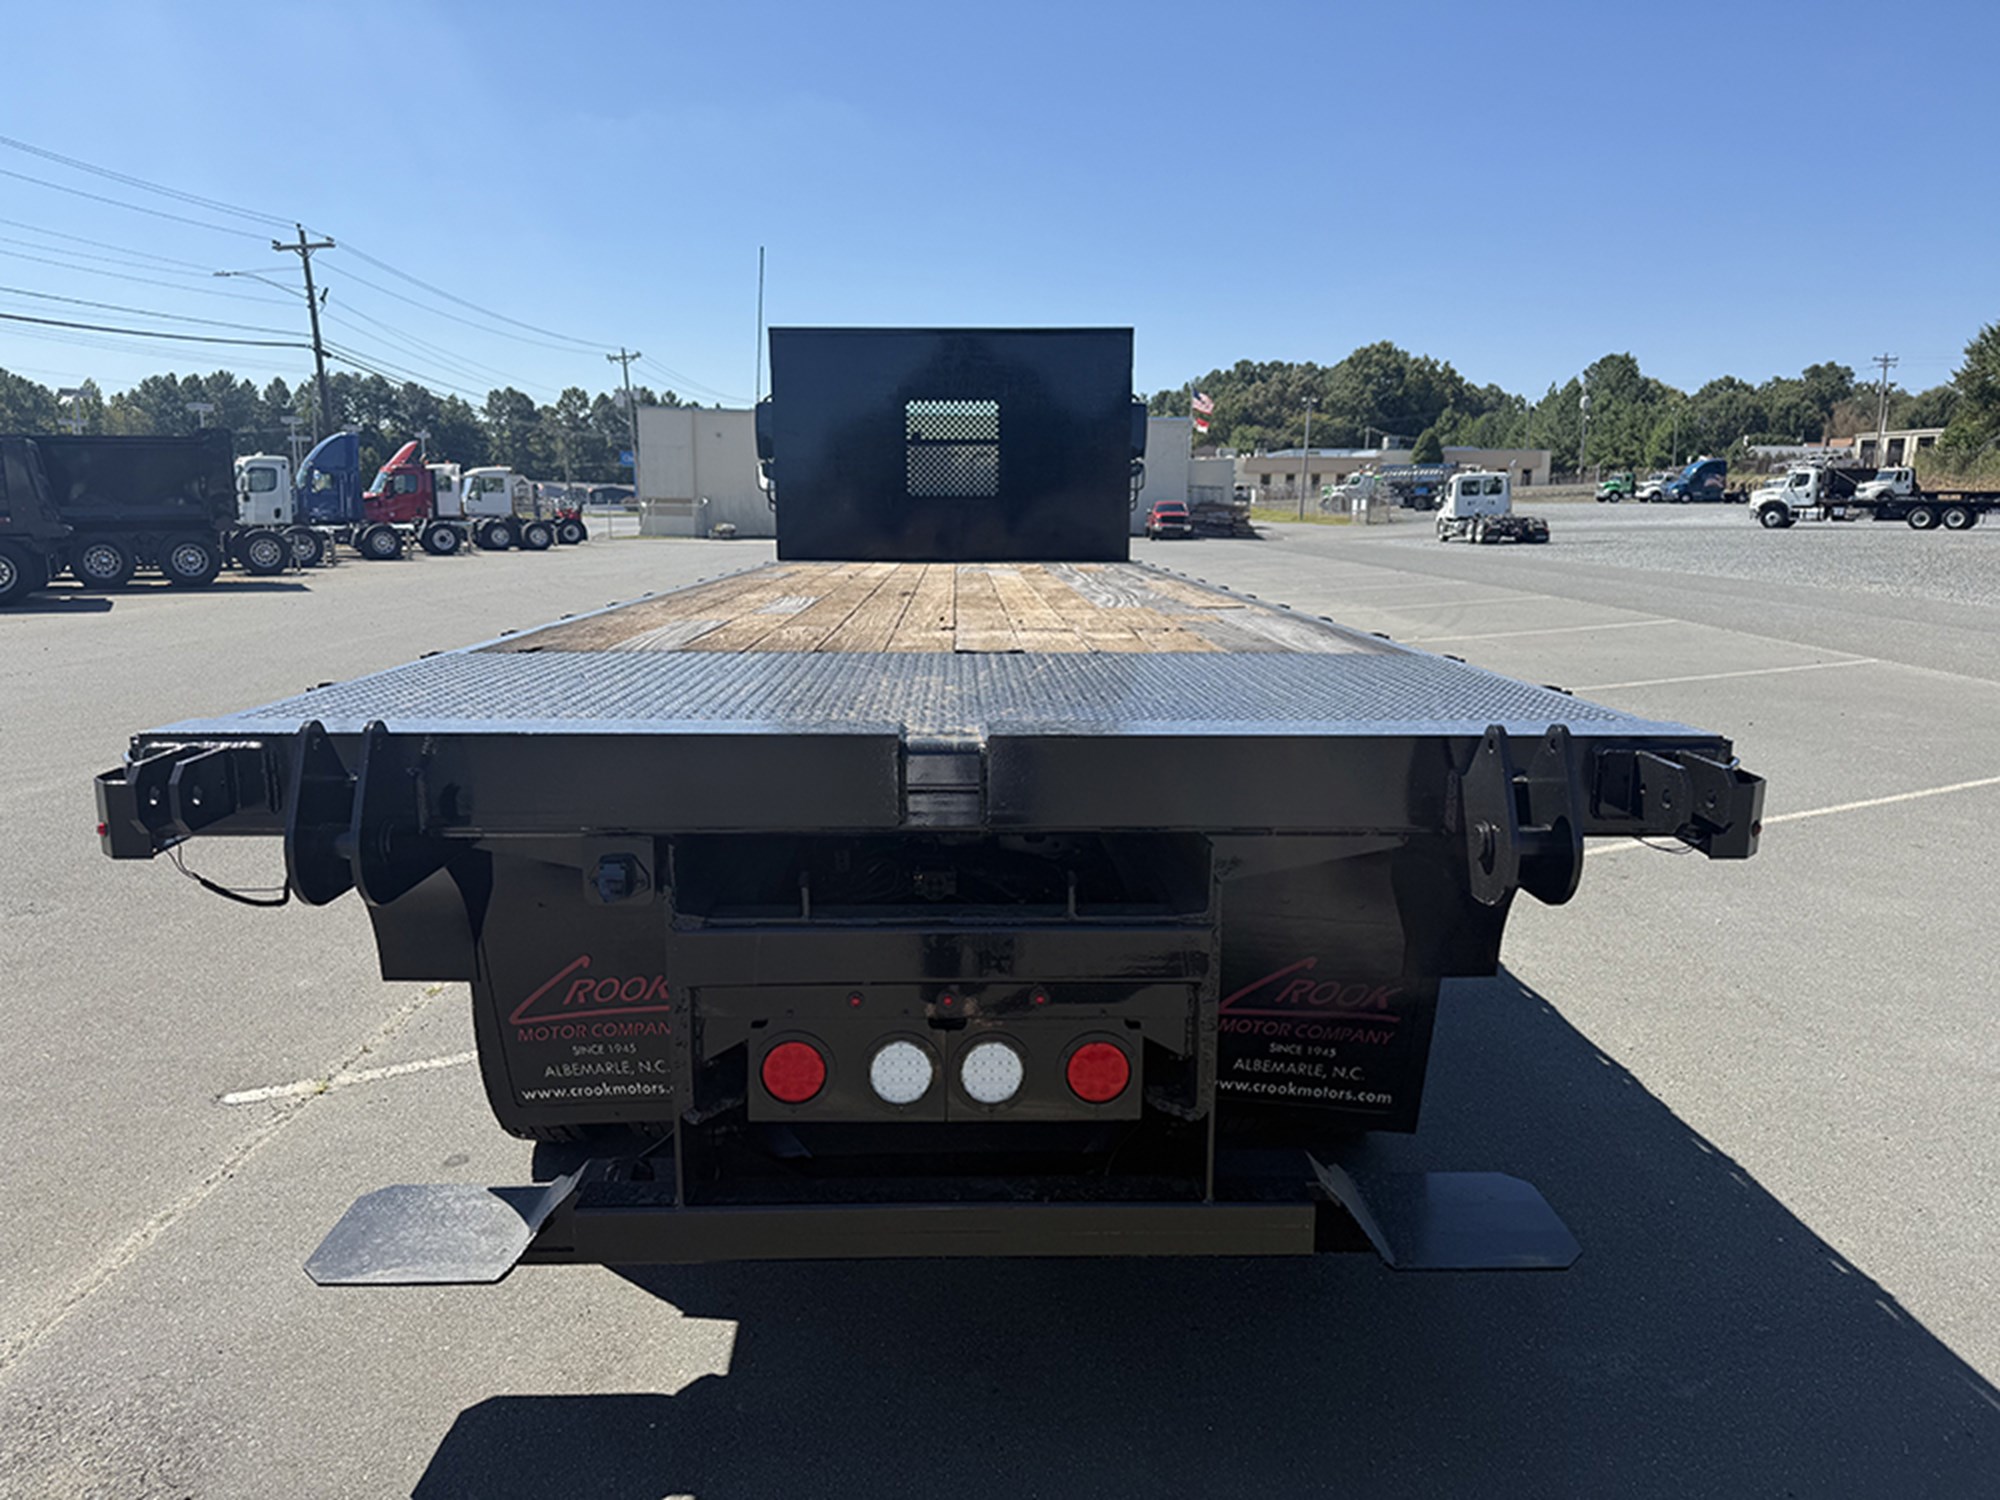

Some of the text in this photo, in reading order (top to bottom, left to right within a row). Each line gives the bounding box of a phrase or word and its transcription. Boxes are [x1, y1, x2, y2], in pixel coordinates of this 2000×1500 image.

[517, 1022, 672, 1042] MOTOR COMPAN
[1219, 1018, 1396, 1046] MOTOR COMPANY
[572, 1043, 637, 1056] SINCE 1945
[1269, 1042, 1337, 1059] SINCE 1945
[544, 1059, 671, 1079] ALBEMARLE, N.C.
[1232, 1057, 1366, 1082] ALBEMARLE, N.C.
[522, 1083, 673, 1100] www.crookmotors.
[1217, 1079, 1393, 1105] ww.crookmotors.com
